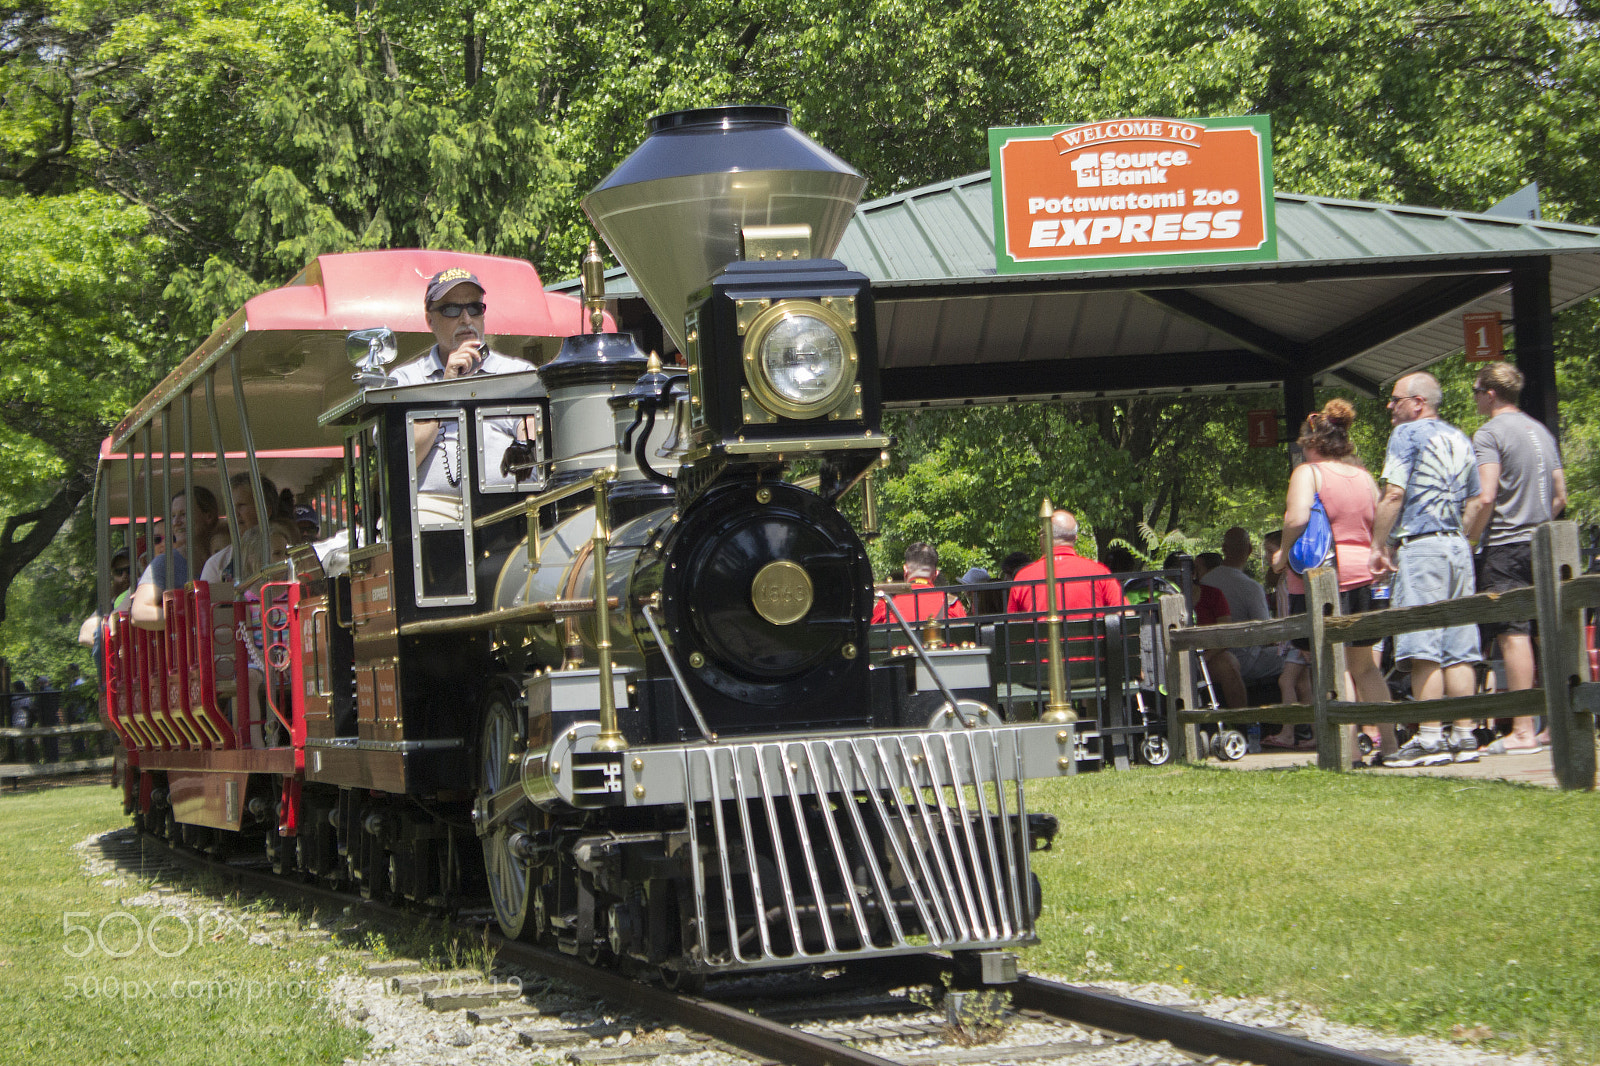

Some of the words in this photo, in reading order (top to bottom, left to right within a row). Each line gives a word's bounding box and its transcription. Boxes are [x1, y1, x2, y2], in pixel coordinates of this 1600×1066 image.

[1061, 121, 1162, 147] WELCOME
[1167, 123, 1197, 141] TO
[1100, 150, 1188, 169] Source
[1101, 166, 1168, 187] Bank
[1028, 189, 1186, 215] Potawatomi
[1192, 189, 1240, 207] Zoo
[1028, 210, 1243, 248] EXPRESS
[1474, 326, 1489, 348] 1
[1256, 420, 1267, 437] 1
